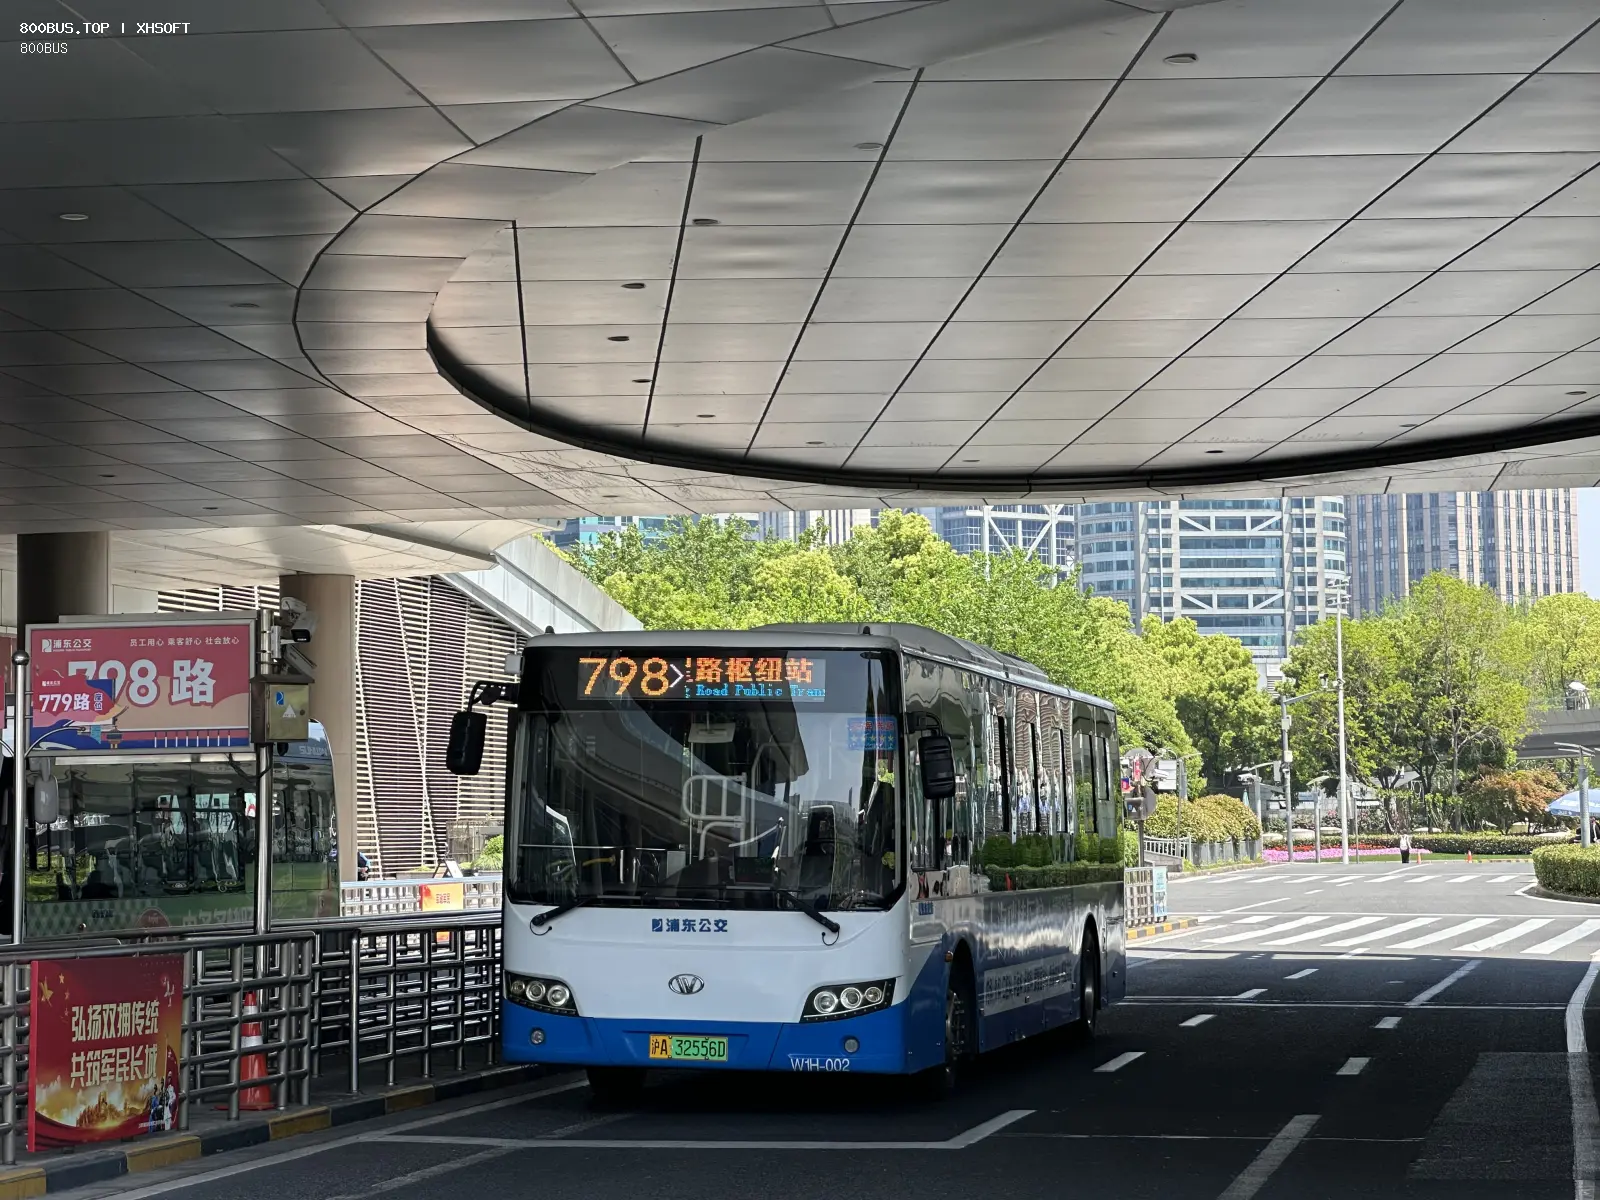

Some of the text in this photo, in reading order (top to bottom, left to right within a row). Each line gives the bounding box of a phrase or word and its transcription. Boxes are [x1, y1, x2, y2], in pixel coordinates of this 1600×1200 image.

[53, 638, 92, 649] 浦东公交
[130, 636, 240, 647] 员工用心 乘客舒心 社会放心
[579, 657, 669, 695] 798
[696, 683, 728, 696] Road
[735, 683, 783, 697] Public
[39, 692, 90, 712] 779路
[666, 918, 728, 933] 浦东公交
[72, 999, 160, 1043] 弘扬双拥传统
[70, 1043, 158, 1088] 共筑军民长城
[790, 1058, 850, 1071] W1H-002
